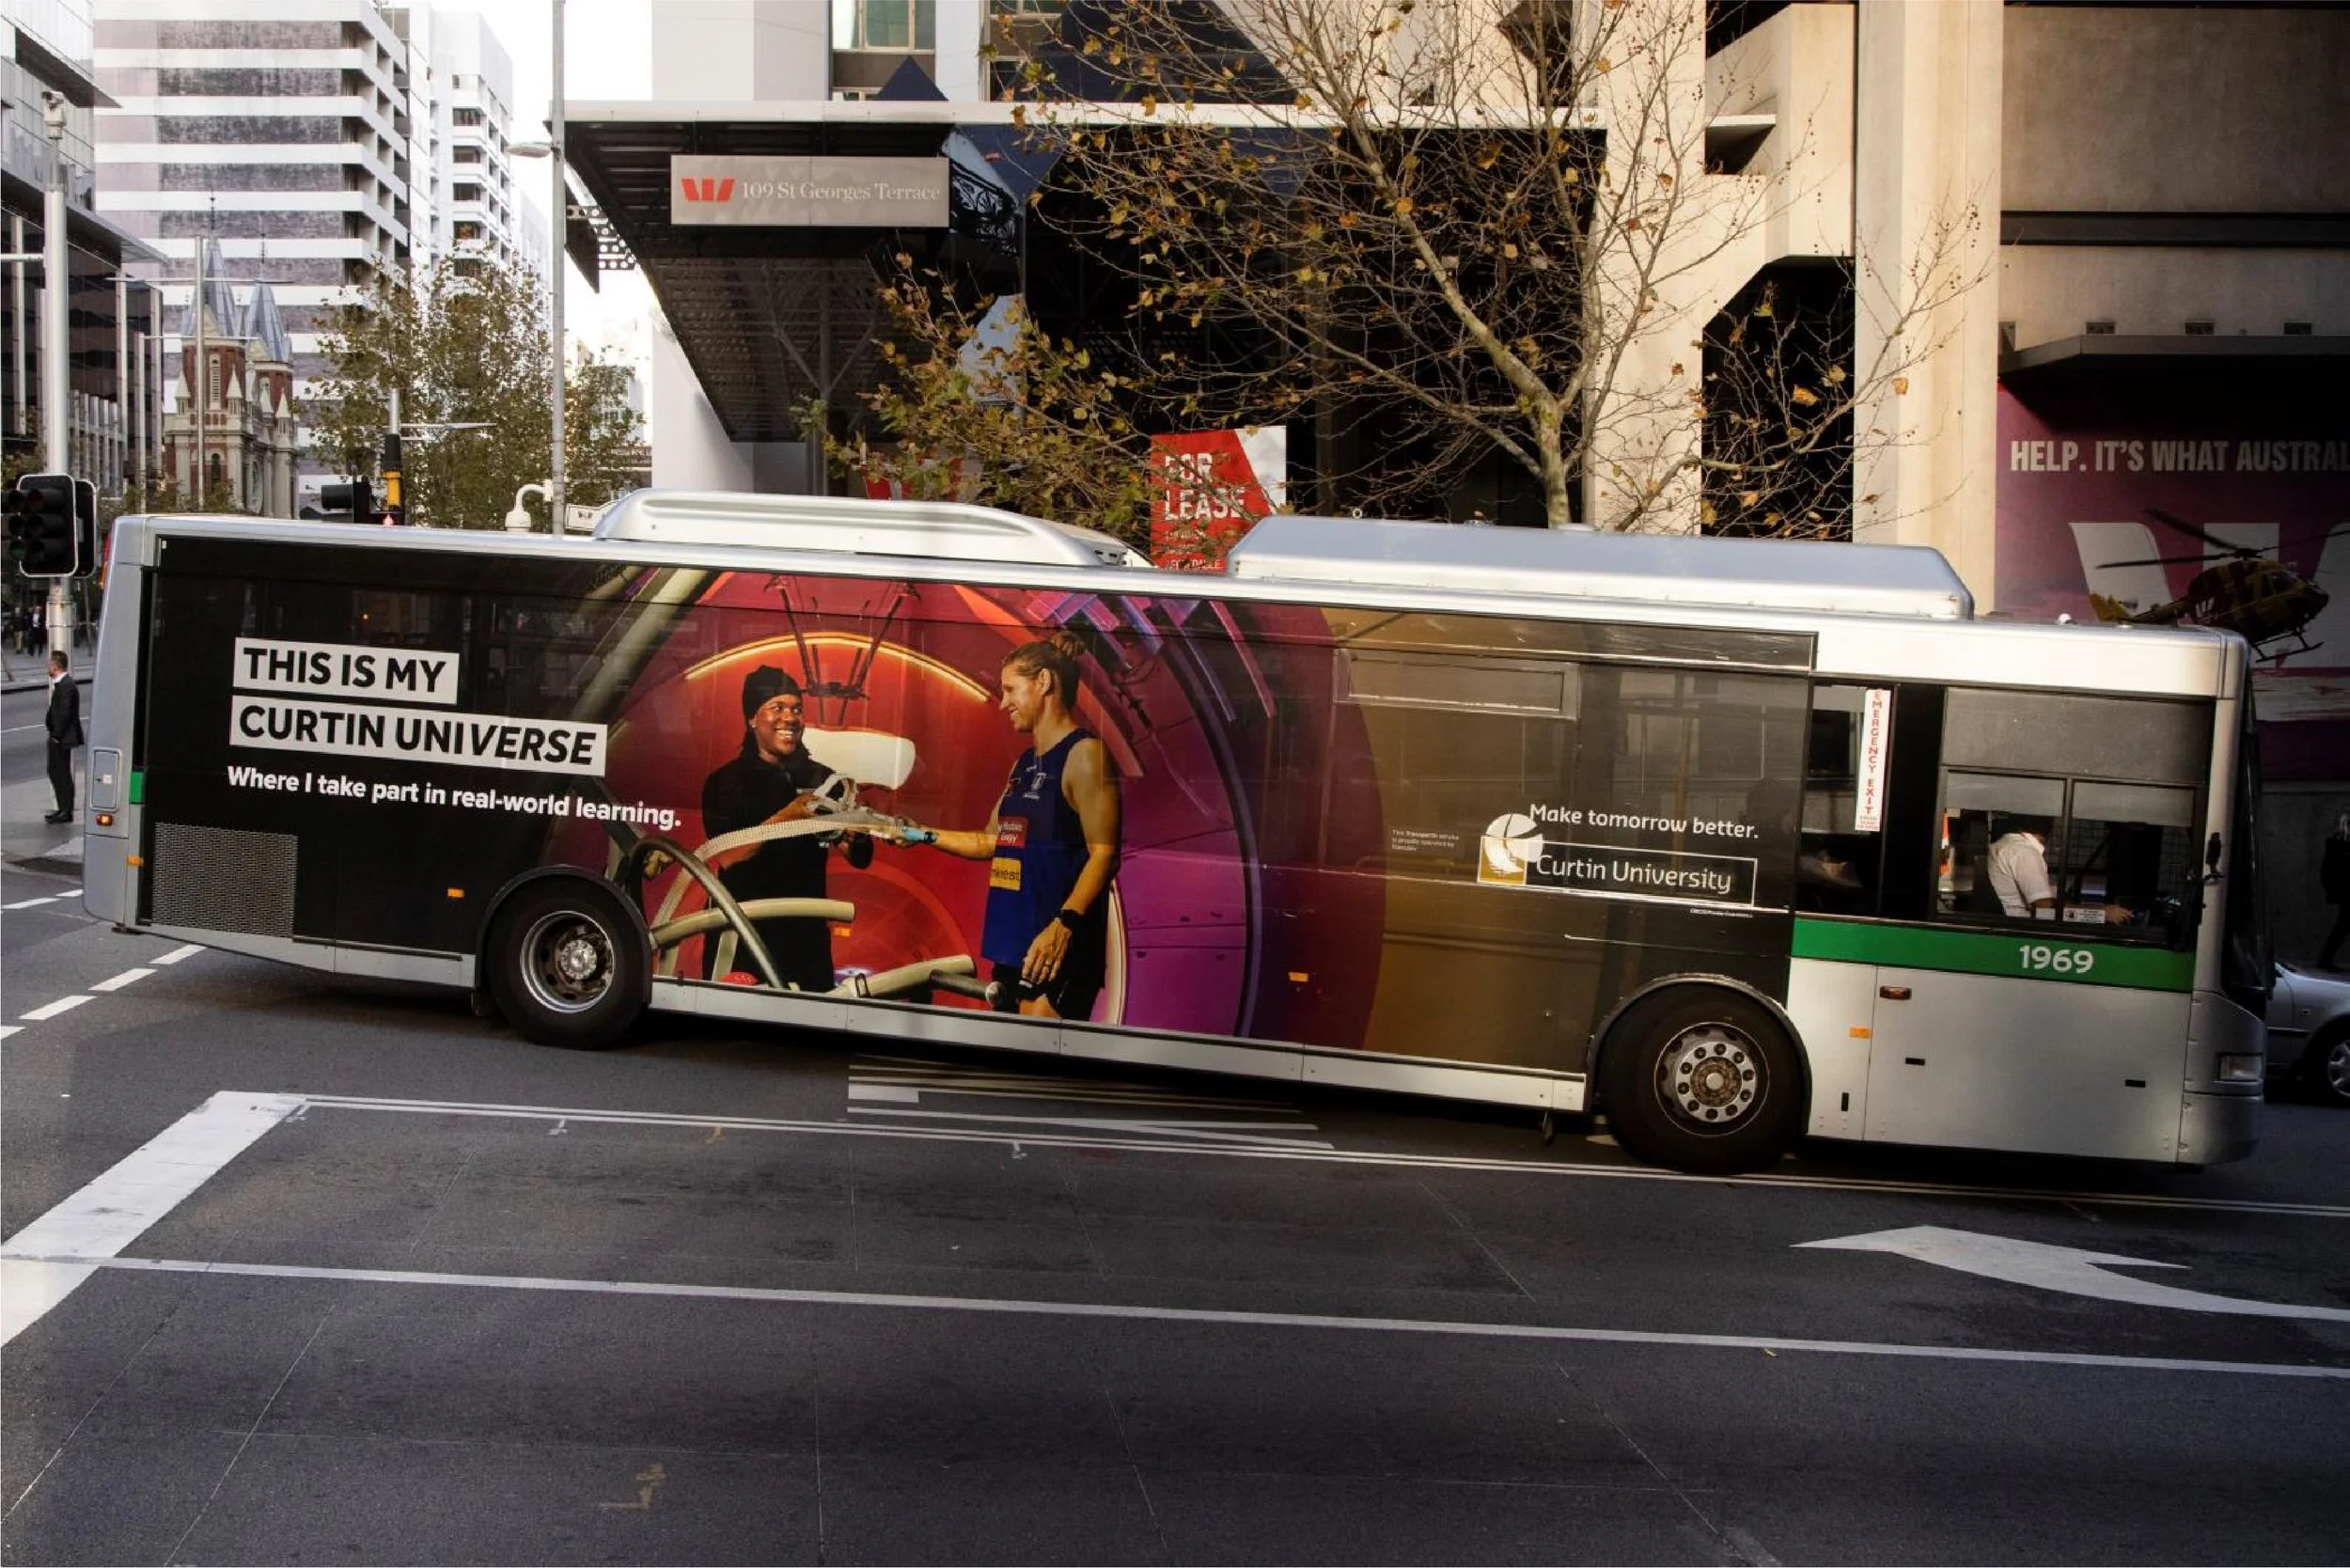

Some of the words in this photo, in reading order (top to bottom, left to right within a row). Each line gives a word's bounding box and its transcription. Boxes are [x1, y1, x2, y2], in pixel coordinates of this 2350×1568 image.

[742, 182, 774, 198] 109
[776, 181, 798, 198] St
[800, 181, 870, 202] Georges
[874, 183, 940, 200] Terrace
[1165, 453, 1214, 483] FOR
[2011, 441, 2087, 471] HELP.
[2095, 441, 2144, 471] IT'S
[2151, 440, 2229, 471] WHAT
[2235, 440, 2350, 472] AUSTRAL
[1165, 487, 1246, 521] LEASE
[243, 647, 331, 685] THIS
[340, 653, 375, 688] IS
[385, 658, 446, 693] MY
[239, 705, 384, 748] CURTIN
[395, 717, 597, 765] UNIVERSE
[1868, 691, 1883, 774] EMERGENCY
[227, 765, 299, 792] Where
[305, 773, 312, 793] I
[317, 775, 366, 798] take
[371, 781, 419, 805] part
[425, 782, 446, 806] in
[451, 789, 570, 817] real-world
[575, 796, 682, 829] learning.
[1865, 778, 1874, 814] EXIT
[1529, 803, 1582, 825] Make
[1588, 809, 1687, 833] tomorrow
[1693, 817, 1759, 839] better.
[1536, 854, 1606, 880] Curtin
[1611, 861, 1731, 895] University
[2019, 945, 2094, 974] 1969
